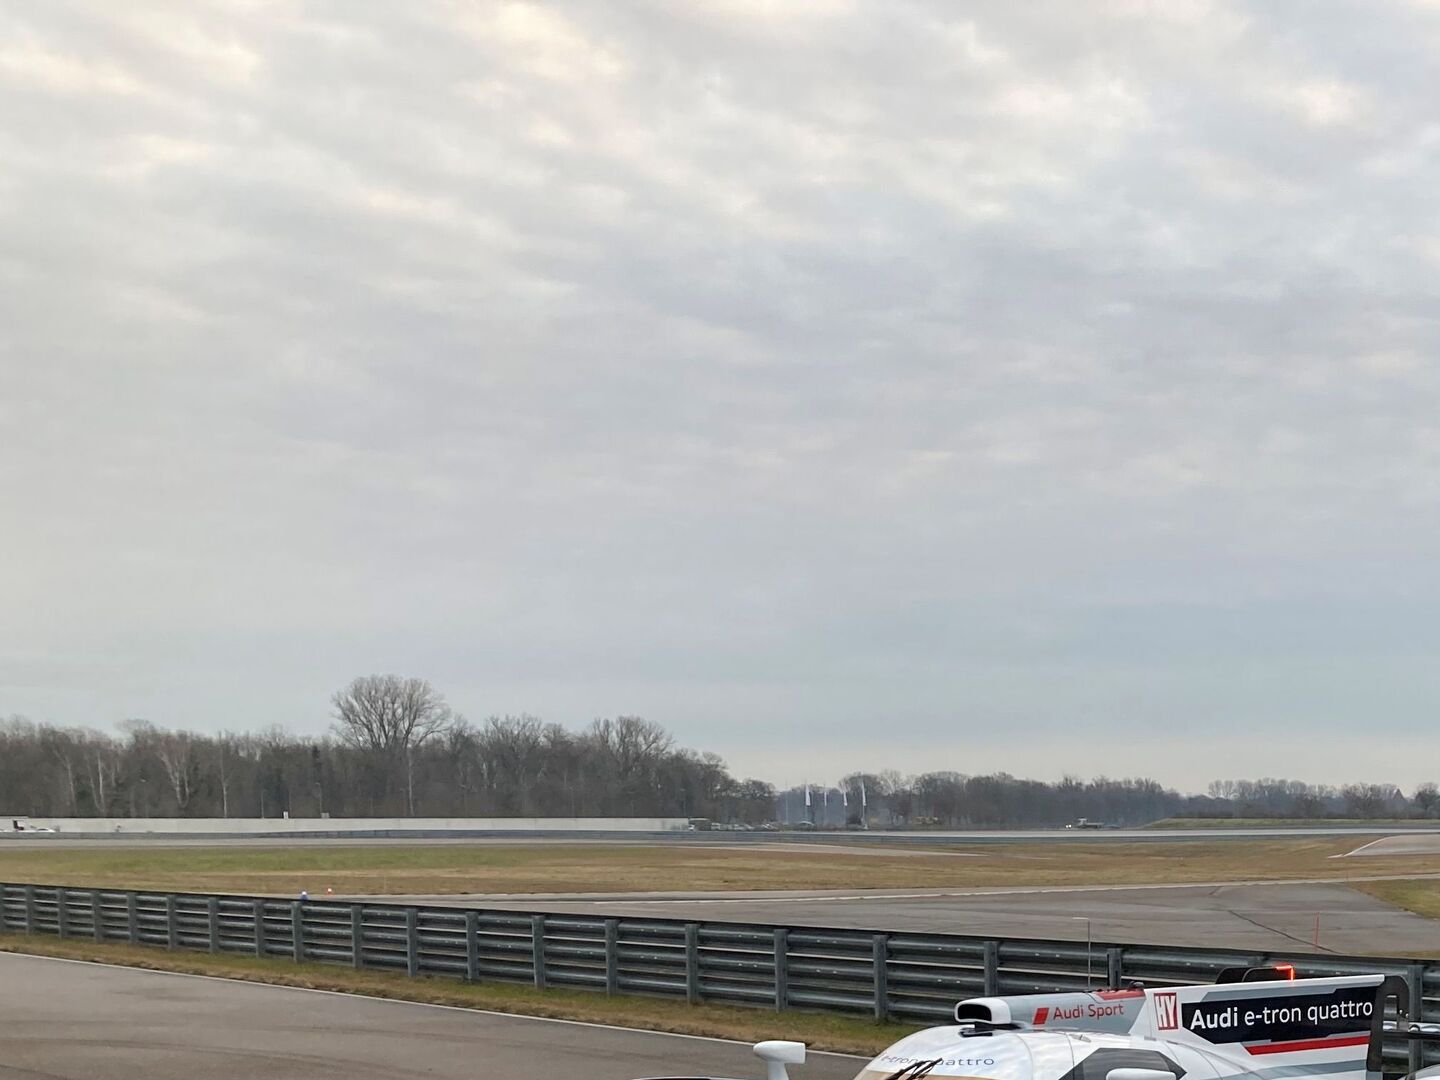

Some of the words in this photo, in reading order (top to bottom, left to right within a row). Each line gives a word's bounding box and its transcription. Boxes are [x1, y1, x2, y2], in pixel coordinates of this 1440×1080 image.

[1053, 1005, 1084, 1020] Audi
[1088, 1003, 1124, 1022] Sport
[1154, 994, 1178, 1028] HY
[1190, 1007, 1239, 1030] Audi
[1244, 1007, 1302, 1026] e-tron
[1307, 1000, 1374, 1025] quattro
[931, 1057, 995, 1067] uattro
